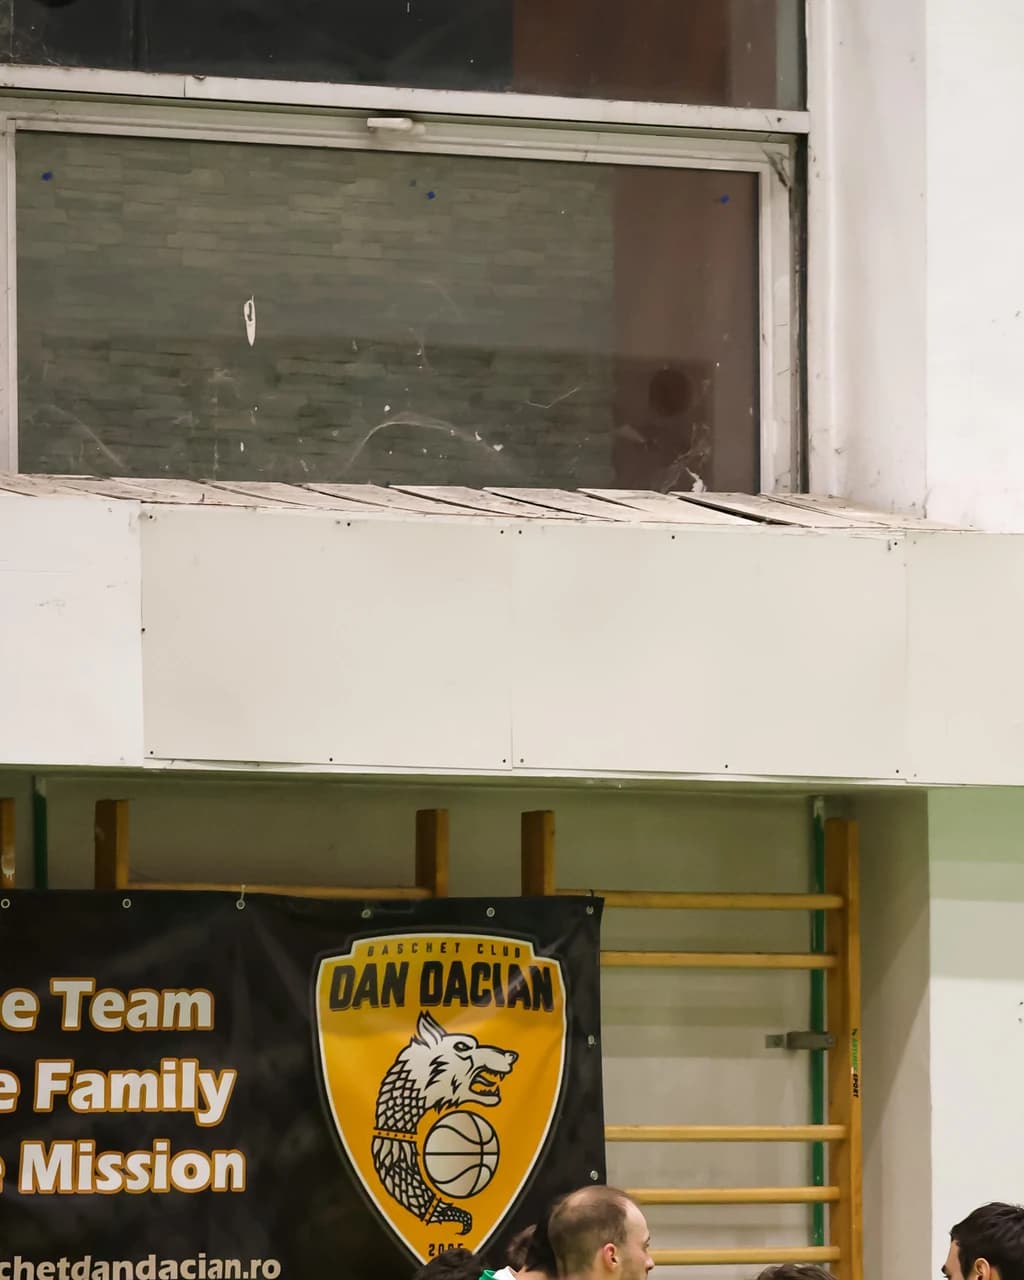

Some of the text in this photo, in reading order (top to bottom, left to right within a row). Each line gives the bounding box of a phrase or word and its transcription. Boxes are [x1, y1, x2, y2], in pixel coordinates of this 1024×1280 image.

[367, 942, 520, 959] BASCHET CLUB
[50, 977, 214, 1032] Team
[328, 961, 554, 1012] DAN DACIAN
[34, 1058, 237, 1127] Family
[18, 1138, 246, 1194] Mission
